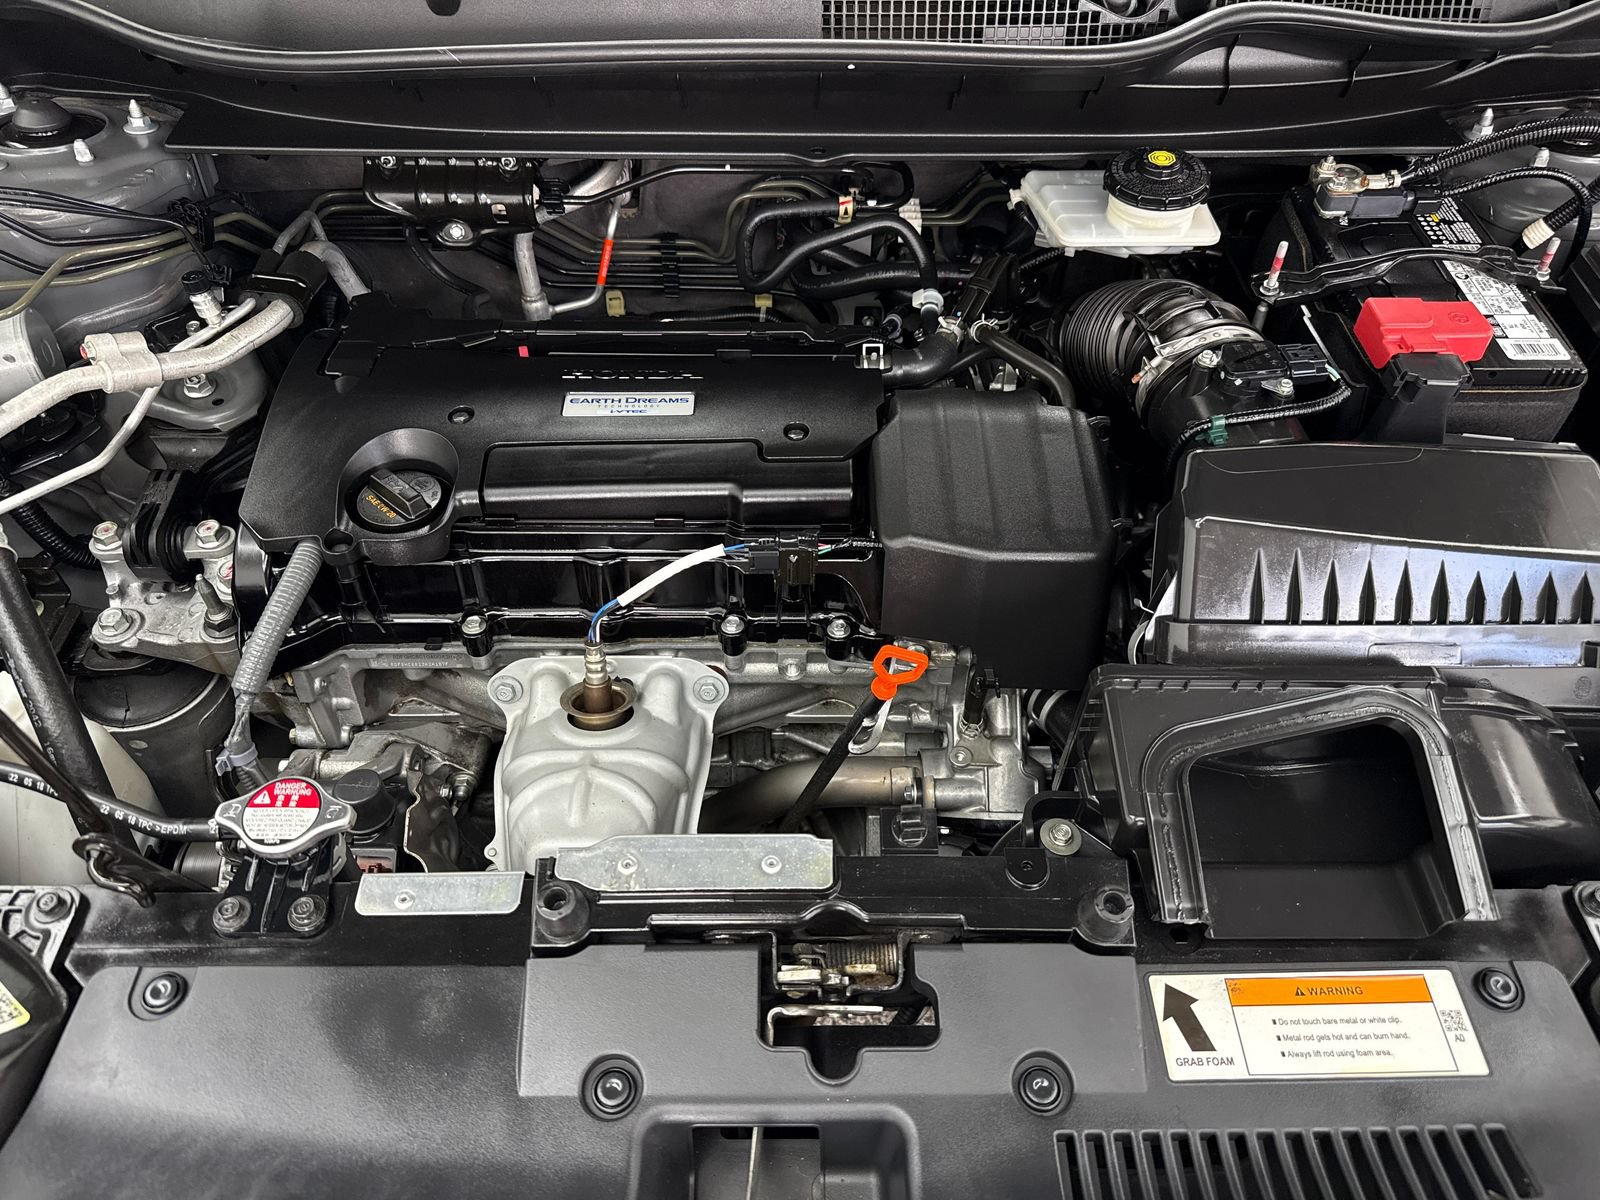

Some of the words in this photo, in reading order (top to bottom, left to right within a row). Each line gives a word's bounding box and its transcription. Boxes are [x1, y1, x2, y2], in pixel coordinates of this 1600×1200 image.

[625, 396, 690, 404] DREAMS
[365, 494, 382, 508] SAE
[8, 772, 19, 783] 22
[23, 776, 33, 787] 05
[36, 781, 45, 791] 18
[275, 781, 307, 789] DANGER
[100, 804, 110, 815] 22
[115, 811, 125, 821] 05
[128, 815, 137, 825] 18
[138, 819, 153, 831] TPC
[1307, 986, 1363, 996] WARNING
[1278, 1017, 1289, 1026] Do
[1289, 1018, 1301, 1026] not
[1301, 1017, 1321, 1025] touch
[1321, 1017, 1338, 1025] bare
[1339, 1016, 1359, 1024] metal
[1368, 1016, 1386, 1024] white
[1282, 1033, 1302, 1041] Metal
[1302, 1033, 1315, 1041] rod
[1316, 1033, 1331, 1043] gets
[1331, 1032, 1344, 1041] hot
[1344, 1033, 1358, 1041] and
[1372, 1032, 1389, 1040] burn
[1287, 1050, 1312, 1060] Always
[1312, 1049, 1322, 1058] lift
[1322, 1049, 1335, 1058] rod
[1335, 1049, 1356, 1059] using
[1355, 1049, 1374, 1057] foam
[1175, 1057, 1204, 1067] GRAB
[1205, 1056, 1236, 1066] FOAM
